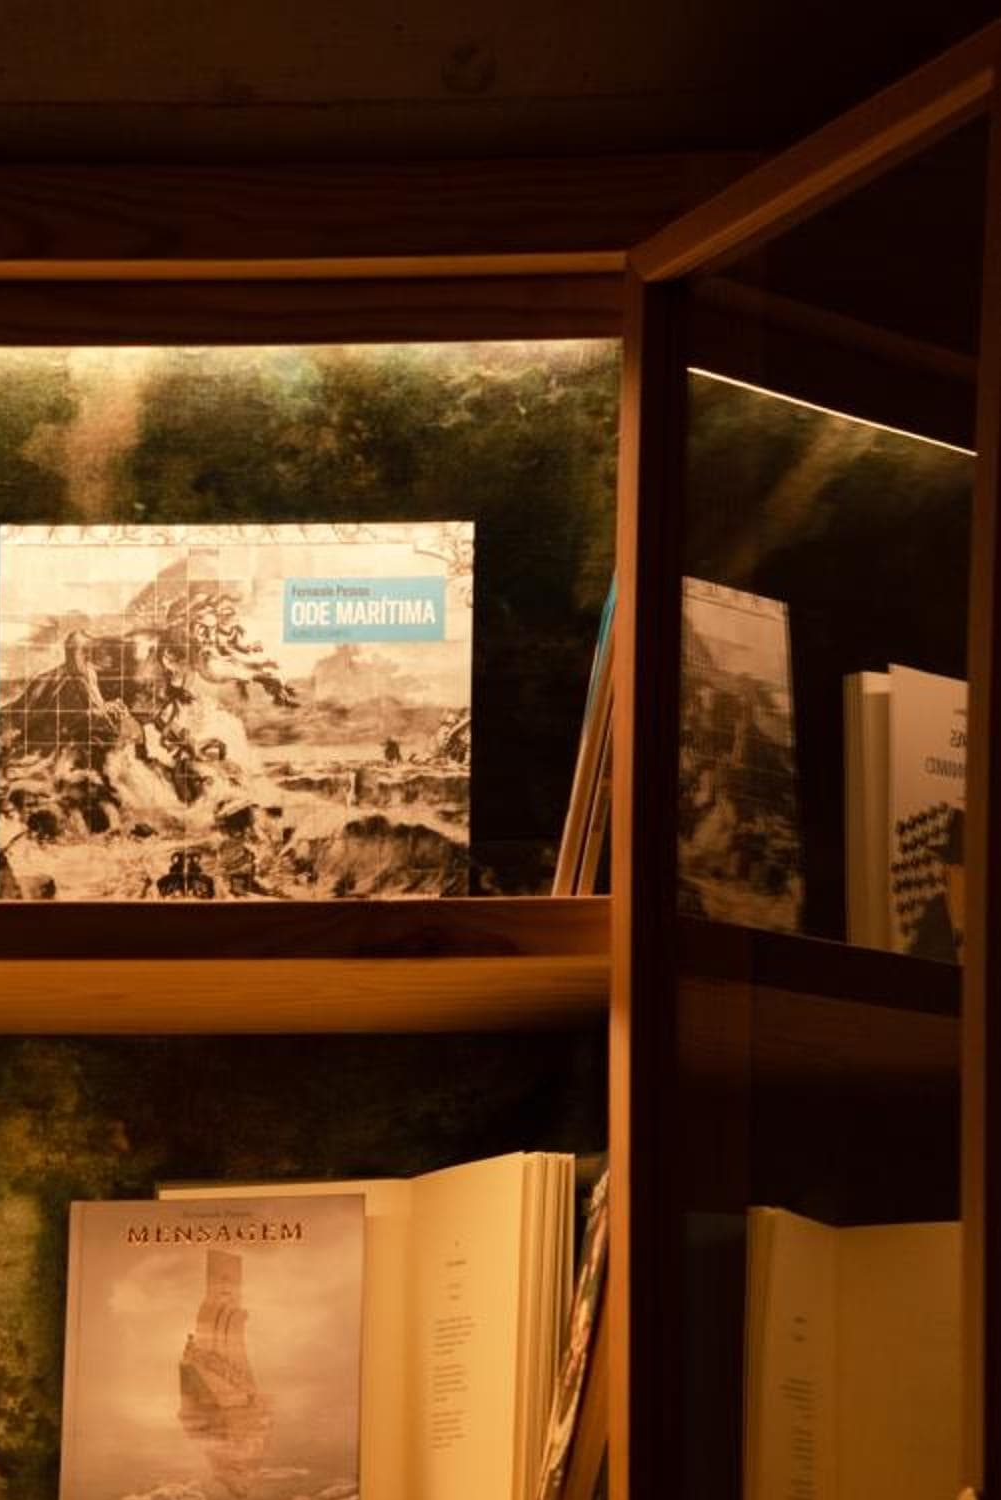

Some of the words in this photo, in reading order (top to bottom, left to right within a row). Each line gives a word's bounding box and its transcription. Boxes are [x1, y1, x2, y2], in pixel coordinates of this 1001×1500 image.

[290, 601, 331, 625] ODE
[335, 597, 436, 625] MARÍTIMA
[127, 1221, 302, 1243] MENSAGEM
